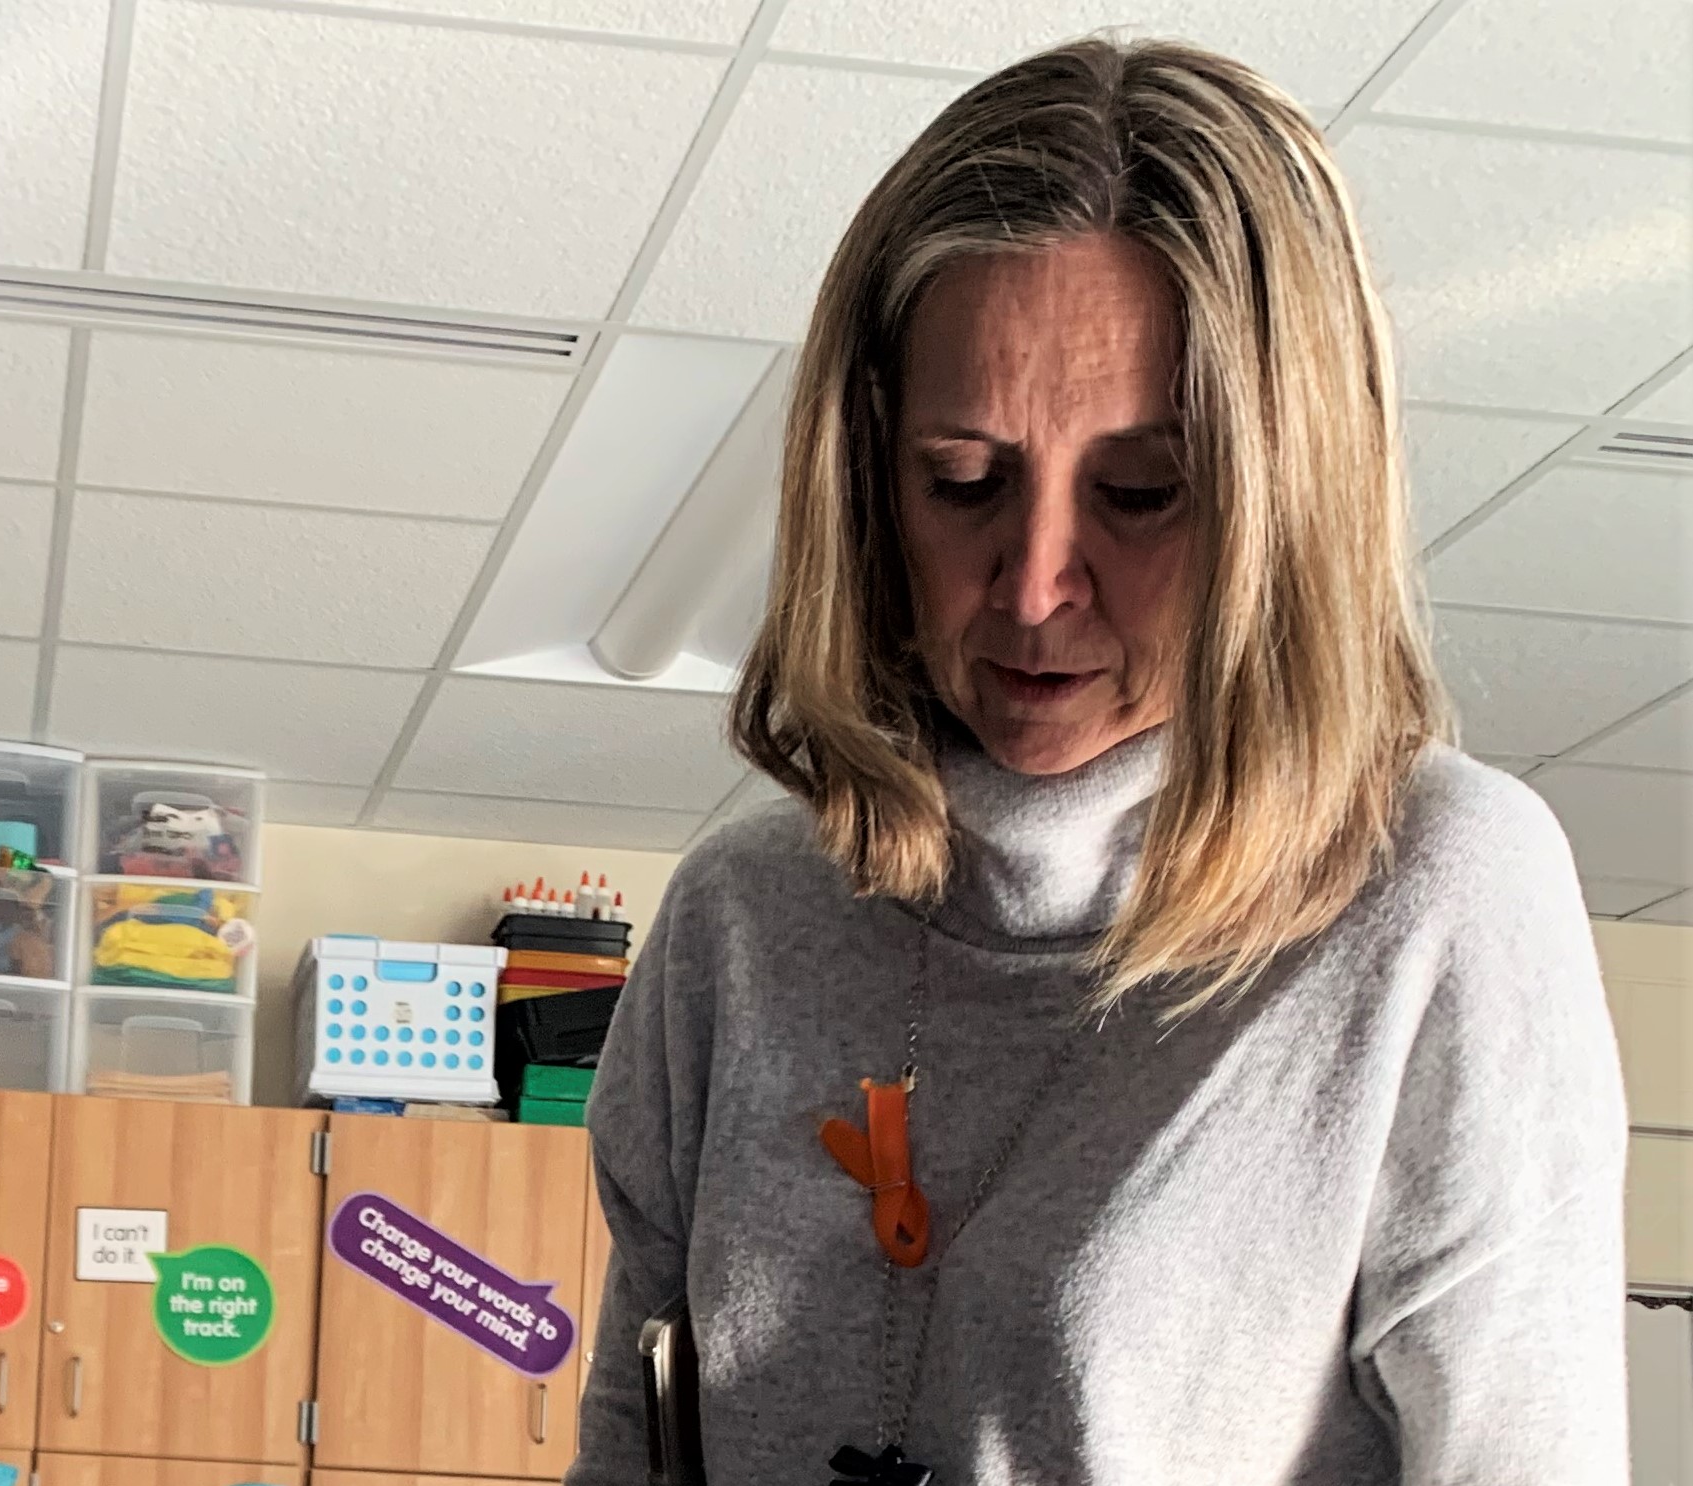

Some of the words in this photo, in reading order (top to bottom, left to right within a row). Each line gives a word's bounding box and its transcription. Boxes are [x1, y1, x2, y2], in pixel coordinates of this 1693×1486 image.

[102, 1224, 149, 1243] can't
[92, 1246, 118, 1264] do
[180, 1271, 213, 1292] I'm
[218, 1276, 246, 1292] on
[358, 1206, 432, 1263] Change
[429, 1254, 479, 1290] your
[477, 1282, 536, 1328] words
[534, 1316, 558, 1341] to
[360, 1238, 432, 1289] change
[429, 1281, 479, 1316] your
[475, 1309, 530, 1352] mind.
[168, 1294, 204, 1315] the
[208, 1295, 259, 1320] right
[182, 1318, 242, 1339] track.
